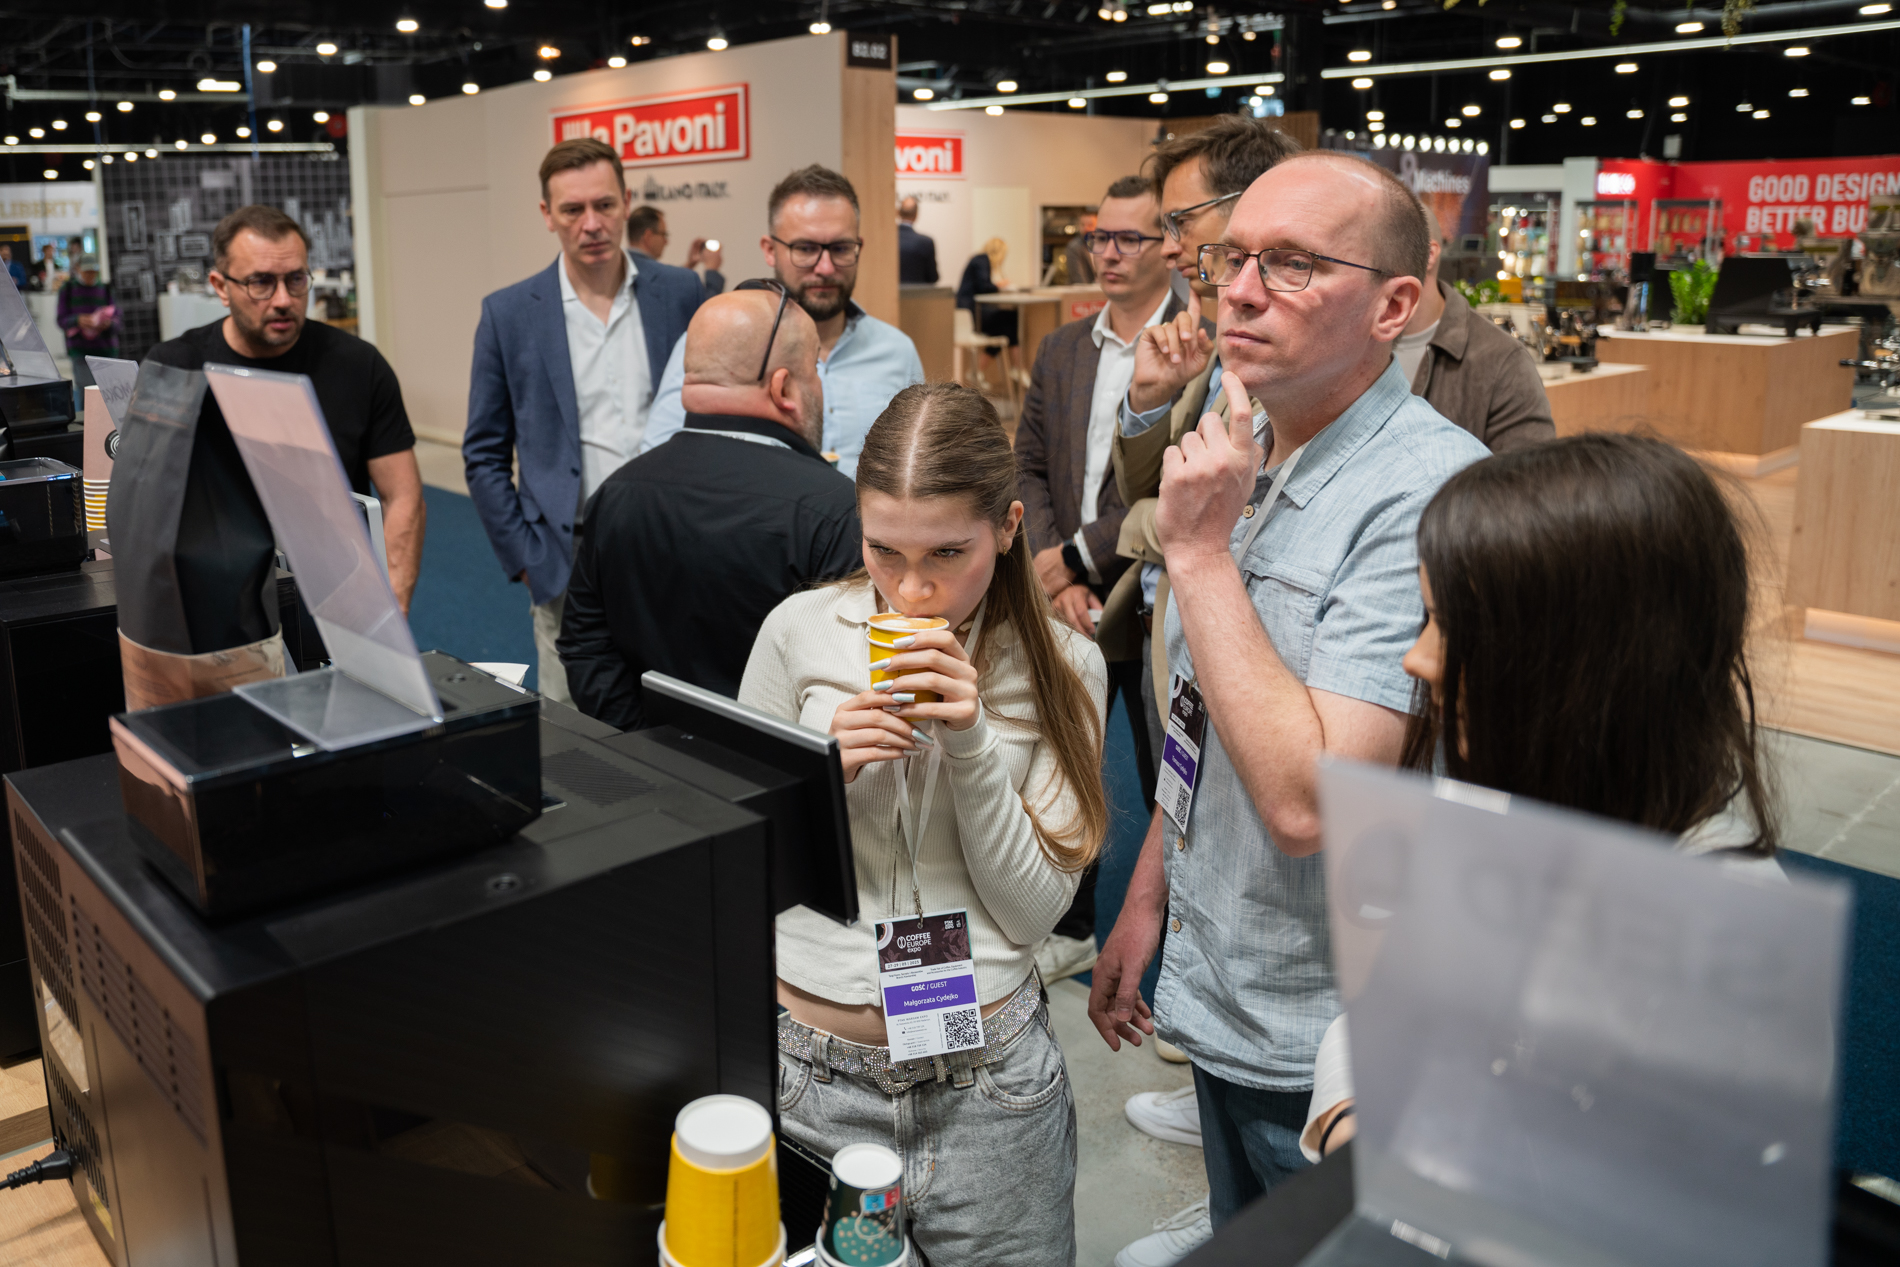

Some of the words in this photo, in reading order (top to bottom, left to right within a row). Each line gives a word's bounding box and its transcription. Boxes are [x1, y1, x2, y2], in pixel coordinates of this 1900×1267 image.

[613, 101, 727, 157] Pavoni
[1414, 168, 1469, 193] Machines
[1749, 175, 1810, 203] GOOD
[1815, 171, 1900, 202] DESIGN
[906, 932, 931, 941] COFFEE
[906, 939, 932, 948] EUROPE
[930, 981, 947, 989] GUEST
[936, 993, 959, 1002] Cydejko
